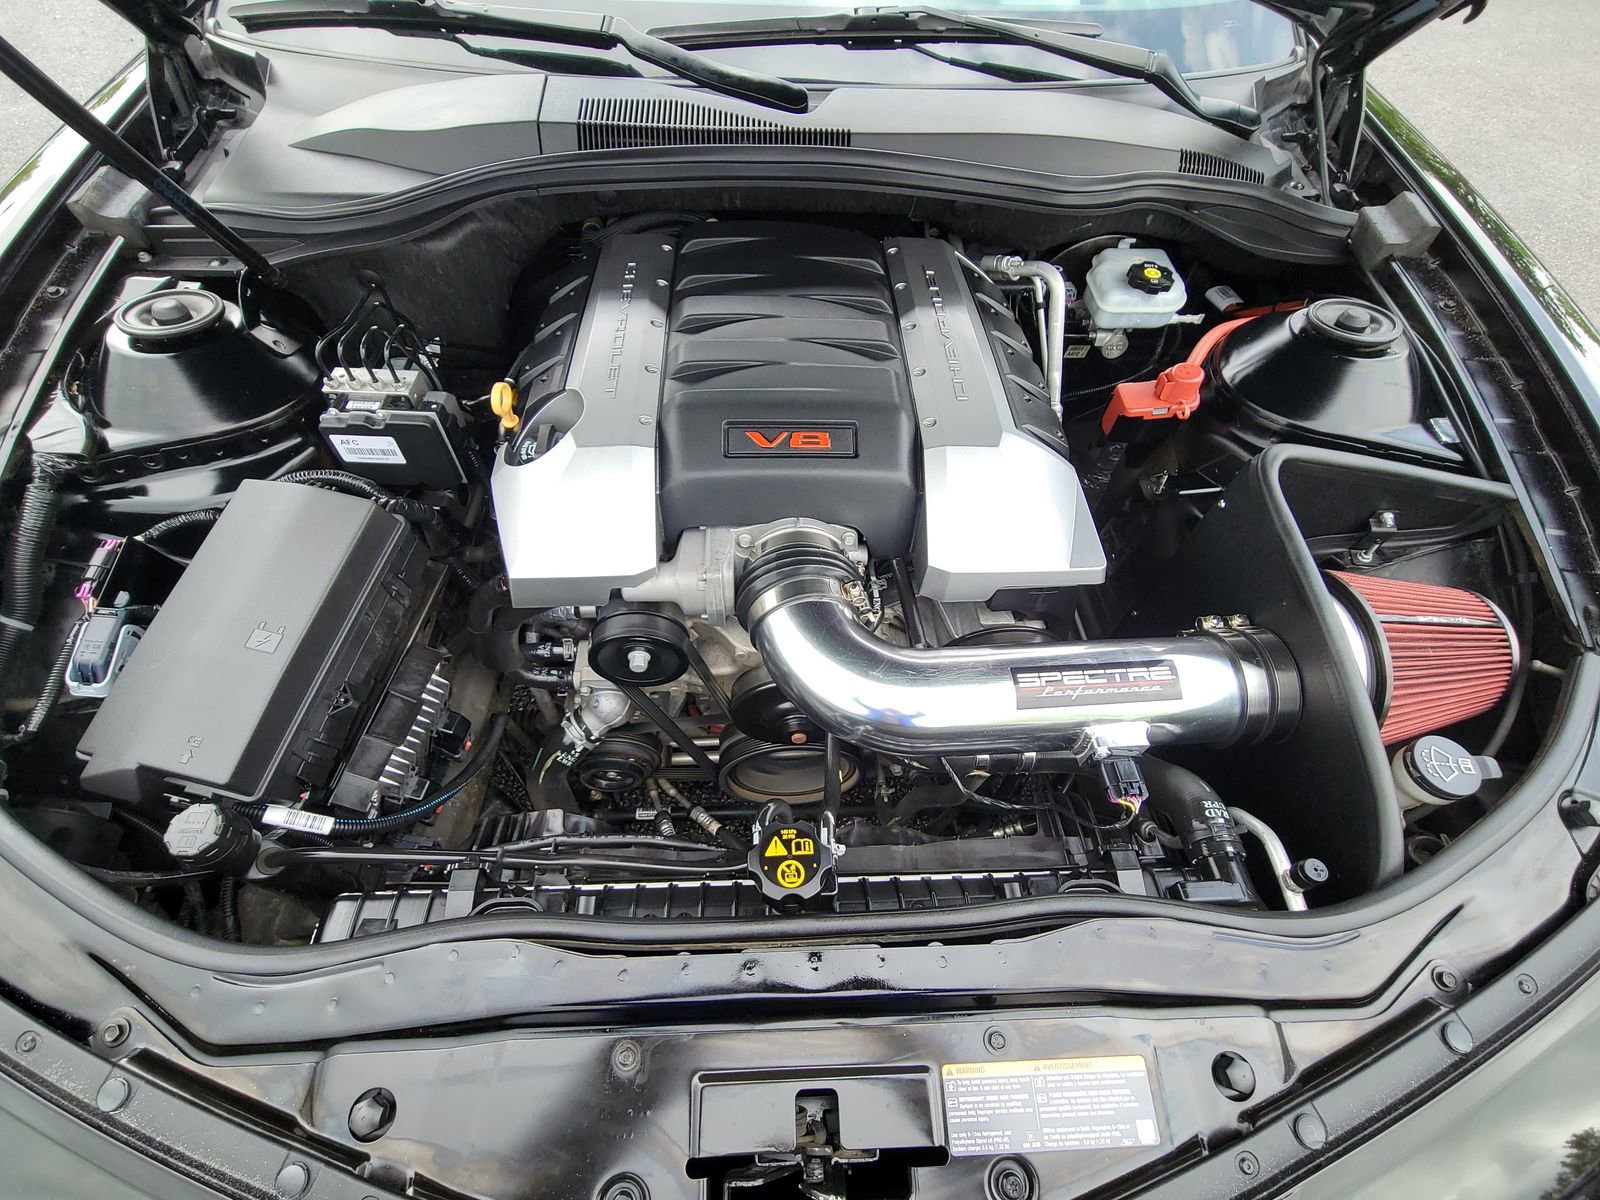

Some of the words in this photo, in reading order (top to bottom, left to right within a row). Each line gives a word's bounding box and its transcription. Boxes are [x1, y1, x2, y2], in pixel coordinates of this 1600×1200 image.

[604, 262, 637, 400] CHEVROLET
[921, 264, 969, 402] CHEVROLET
[745, 431, 832, 449] V8
[1017, 666, 1173, 688] SPECTRE
[1036, 684, 1164, 700] Performance
[1204, 808, 1230, 819] RAD
[956, 1066, 985, 1074] WARNING
[1043, 1062, 1092, 1070] AVERTISSEMENT
